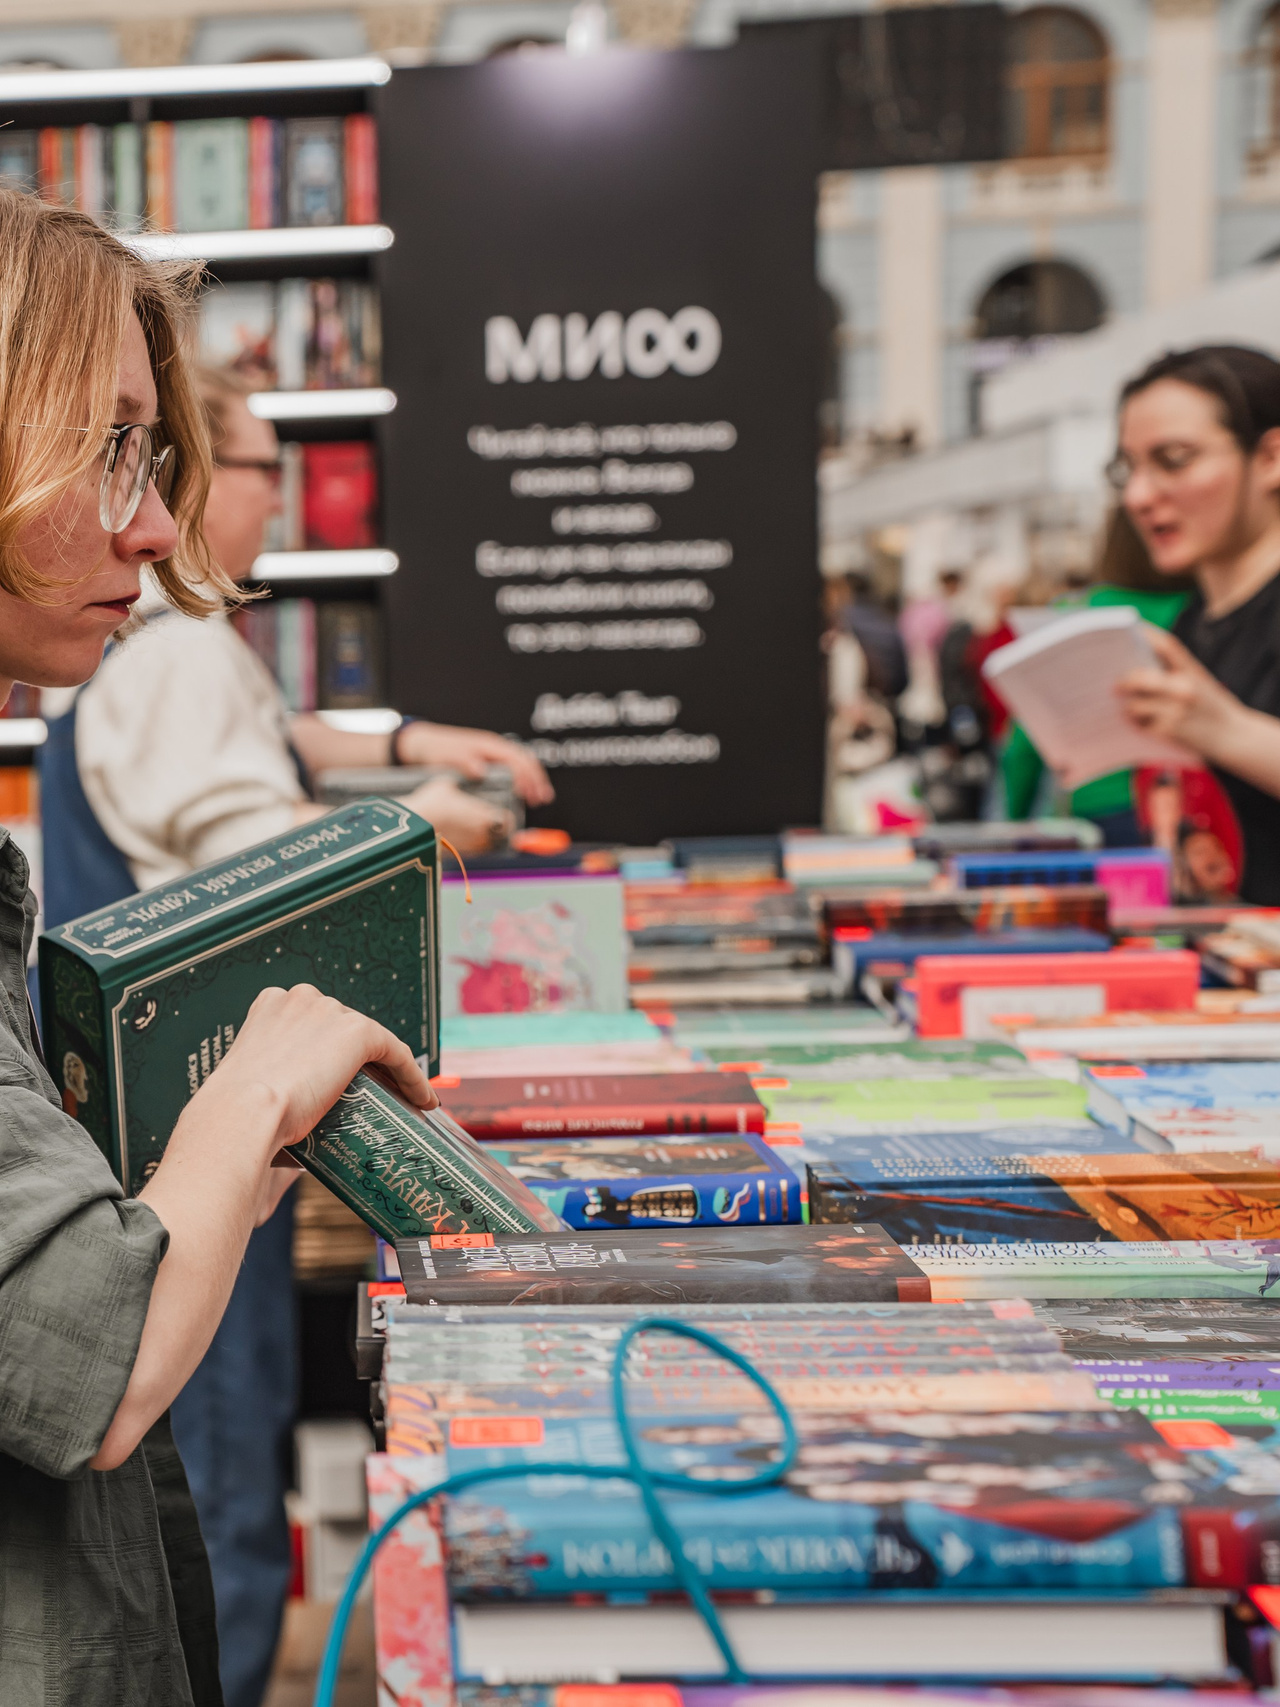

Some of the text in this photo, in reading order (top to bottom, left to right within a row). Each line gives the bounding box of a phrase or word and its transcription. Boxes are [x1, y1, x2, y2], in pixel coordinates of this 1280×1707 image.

[278, 823, 351, 860] МИСТЕР
[320, 1140, 363, 1178] ВЛАДИМИР
[334, 1138, 362, 1165] ТОРИН
[375, 1154, 456, 1232] КАНУН
[456, 1246, 511, 1272] МИСТЕ
[562, 1536, 713, 1578] БРТОМ
